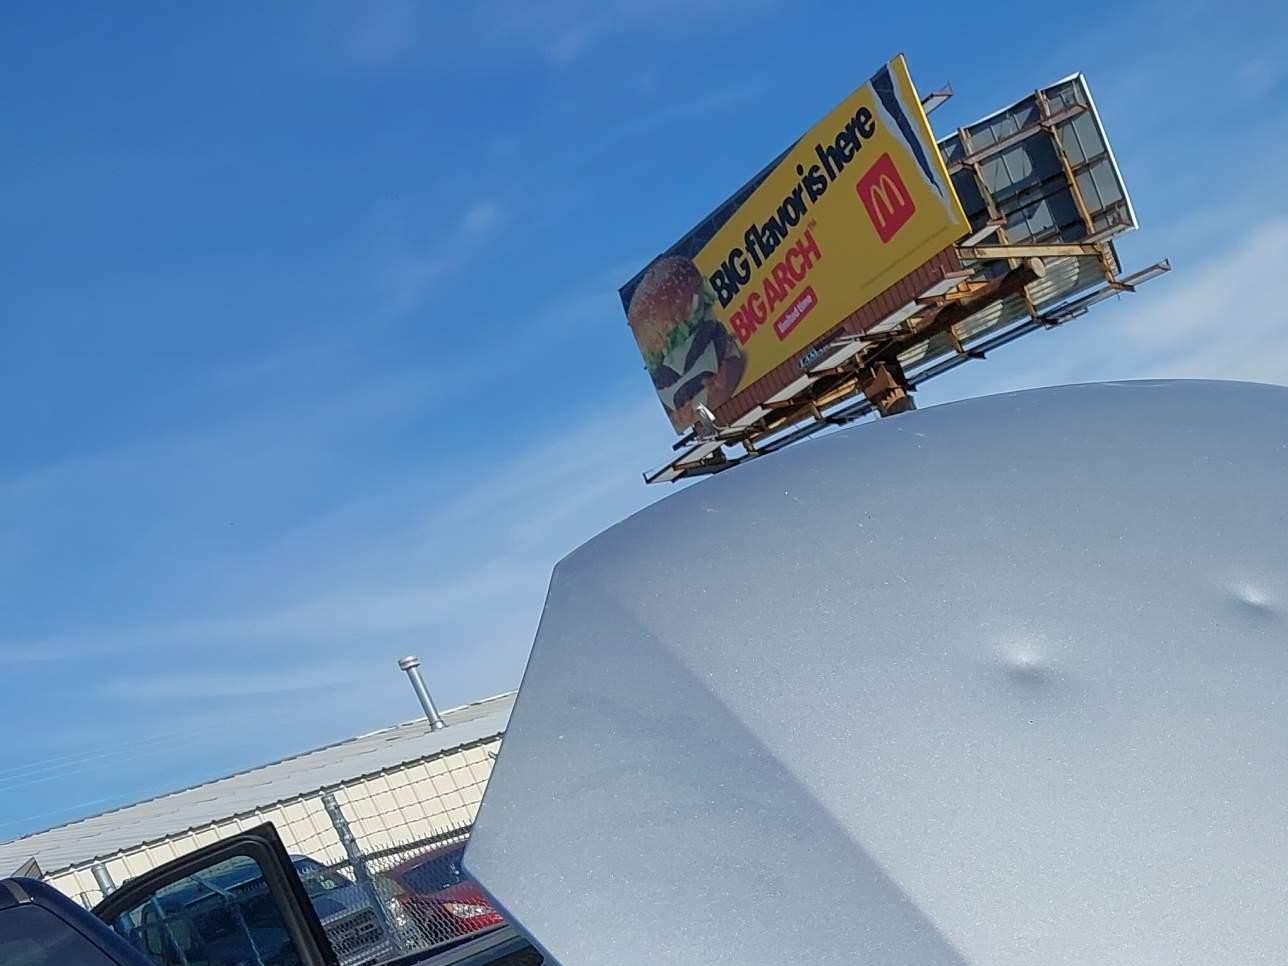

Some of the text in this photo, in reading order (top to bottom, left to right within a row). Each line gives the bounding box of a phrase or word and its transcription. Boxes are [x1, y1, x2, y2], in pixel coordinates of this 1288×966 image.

[709, 106, 875, 309] BIG flavor is here
[729, 292, 767, 346] BIG
